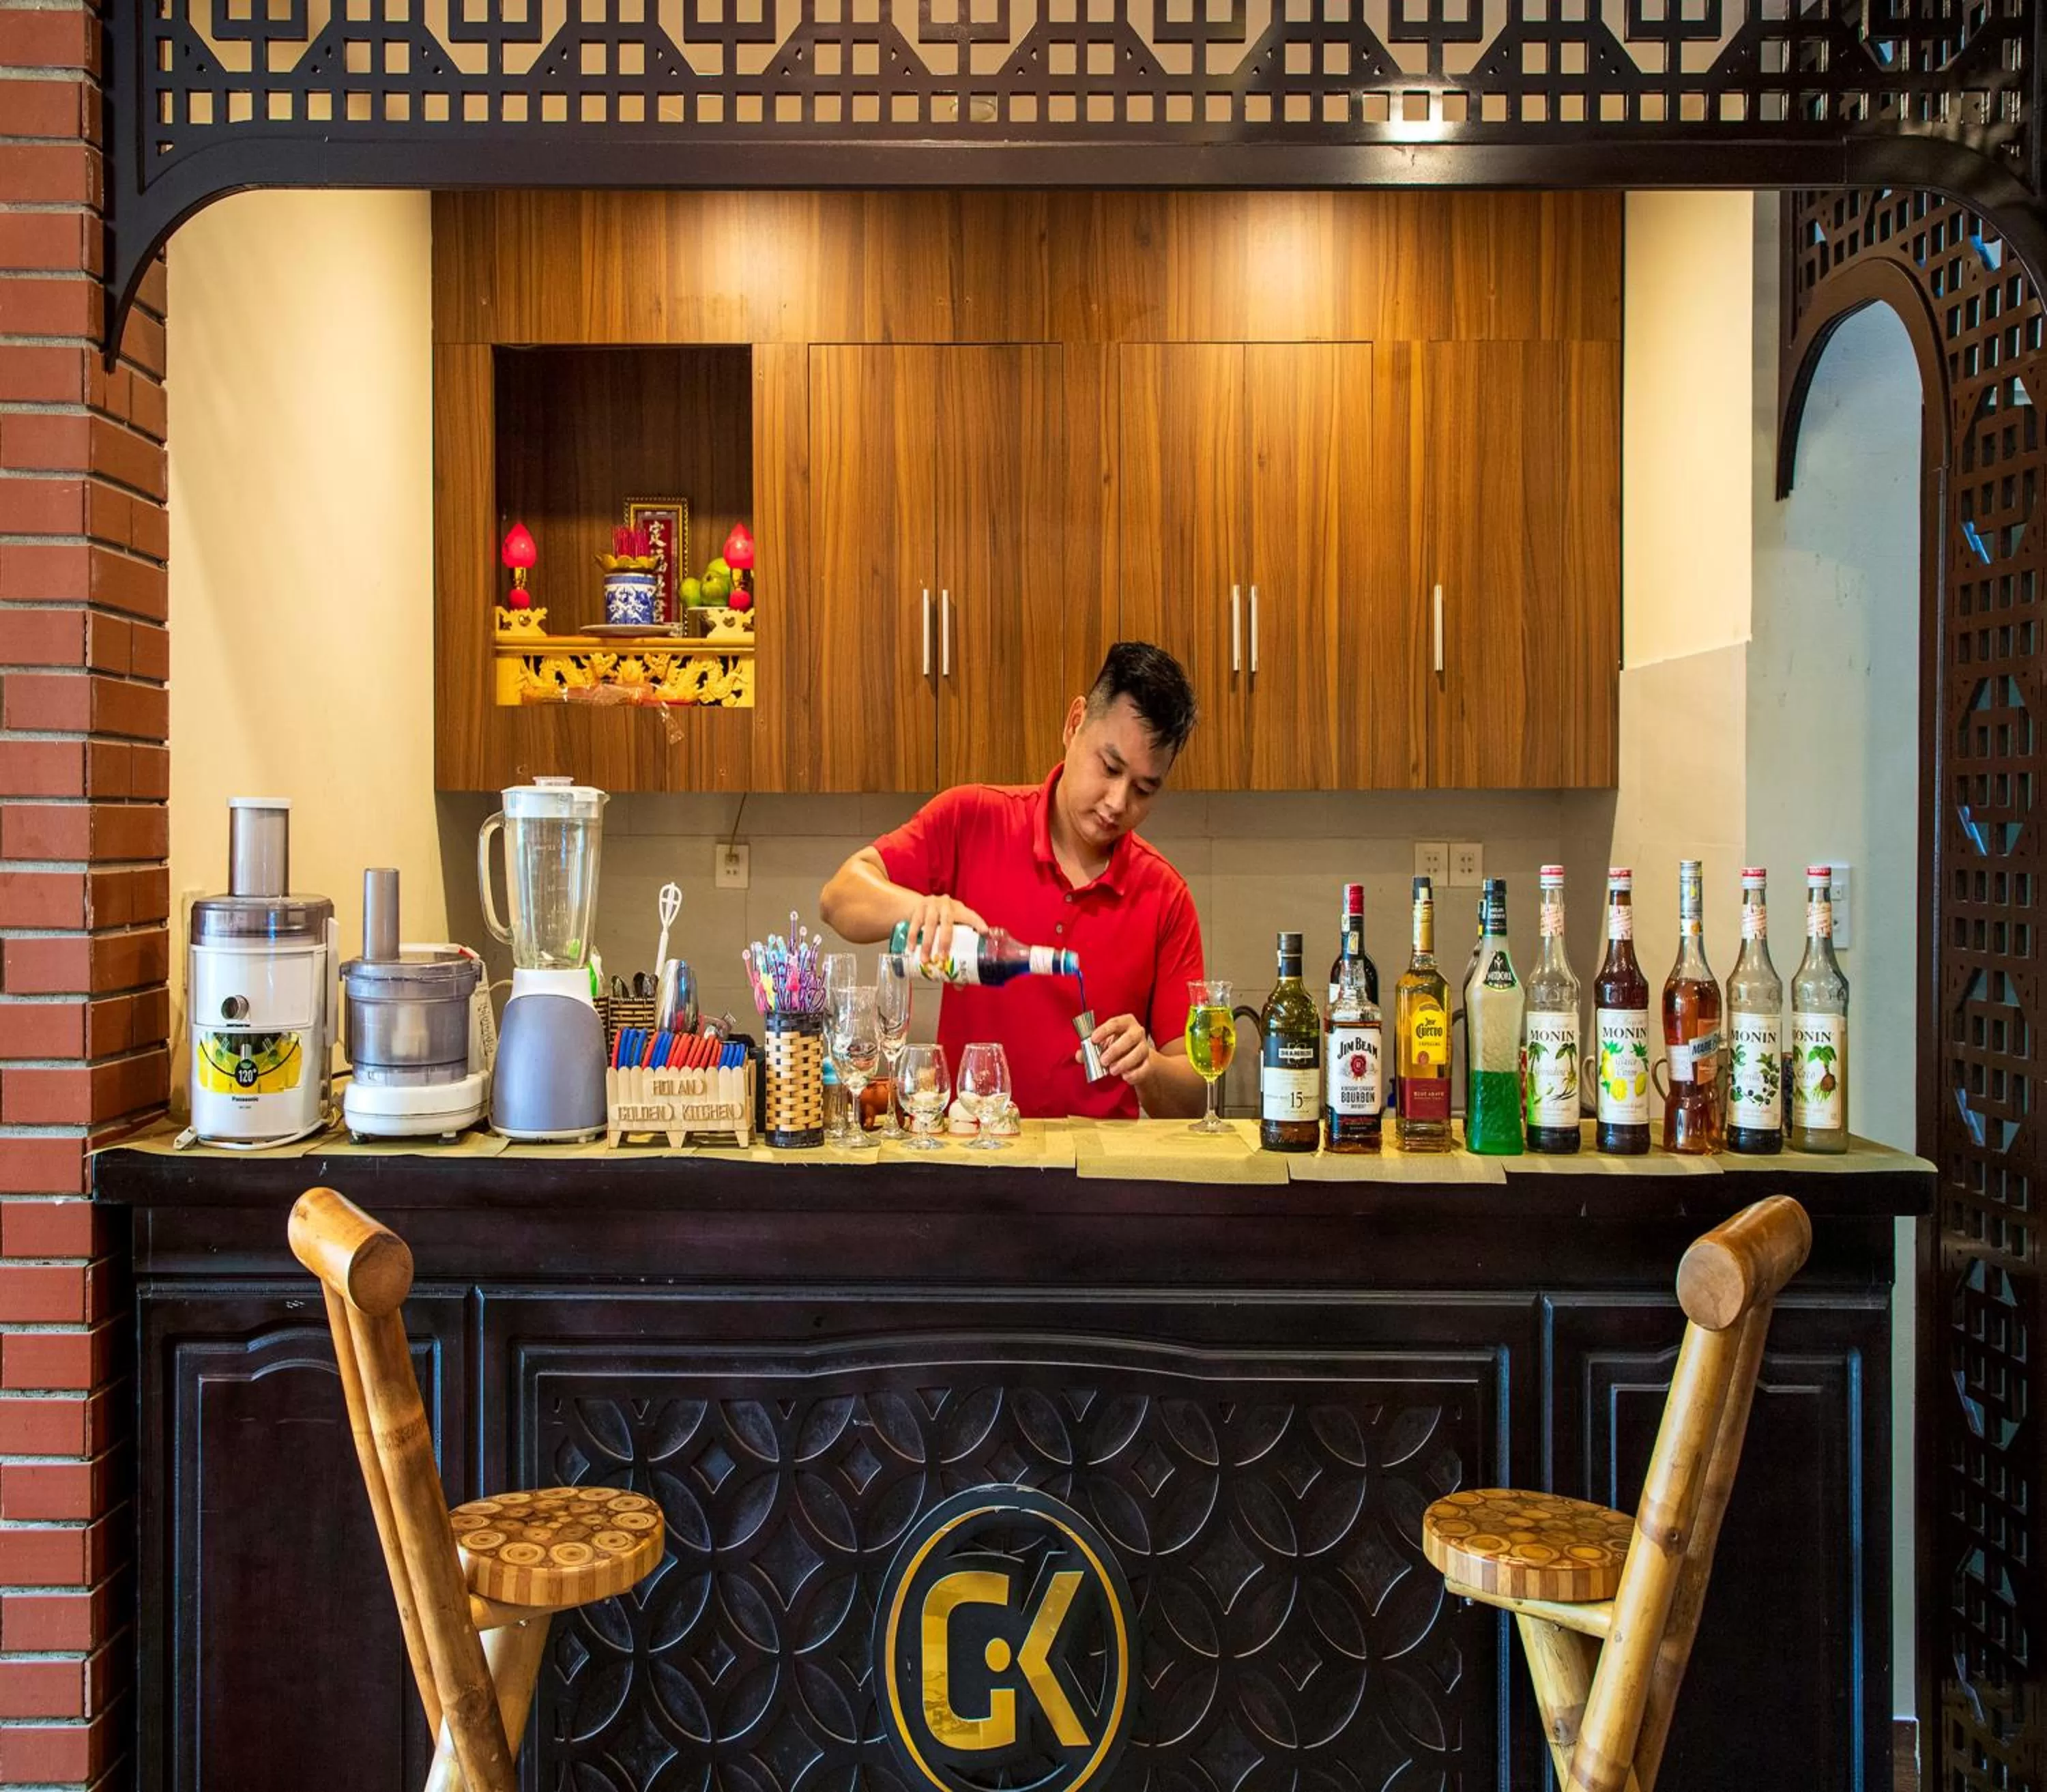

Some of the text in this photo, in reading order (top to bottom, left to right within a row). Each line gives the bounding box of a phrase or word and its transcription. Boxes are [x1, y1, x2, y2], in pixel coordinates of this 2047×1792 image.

[1416, 1024, 1443, 1039] Cuervo
[1530, 1030, 1575, 1042] MONIN
[1603, 1027, 1647, 1039] MONIN
[1337, 1037, 1378, 1059] JIM BEAM
[1290, 1091, 1303, 1109] 15
[1341, 1091, 1375, 1103] BOURBON
[618, 1103, 735, 1121] GOLDEN KITCHEN
